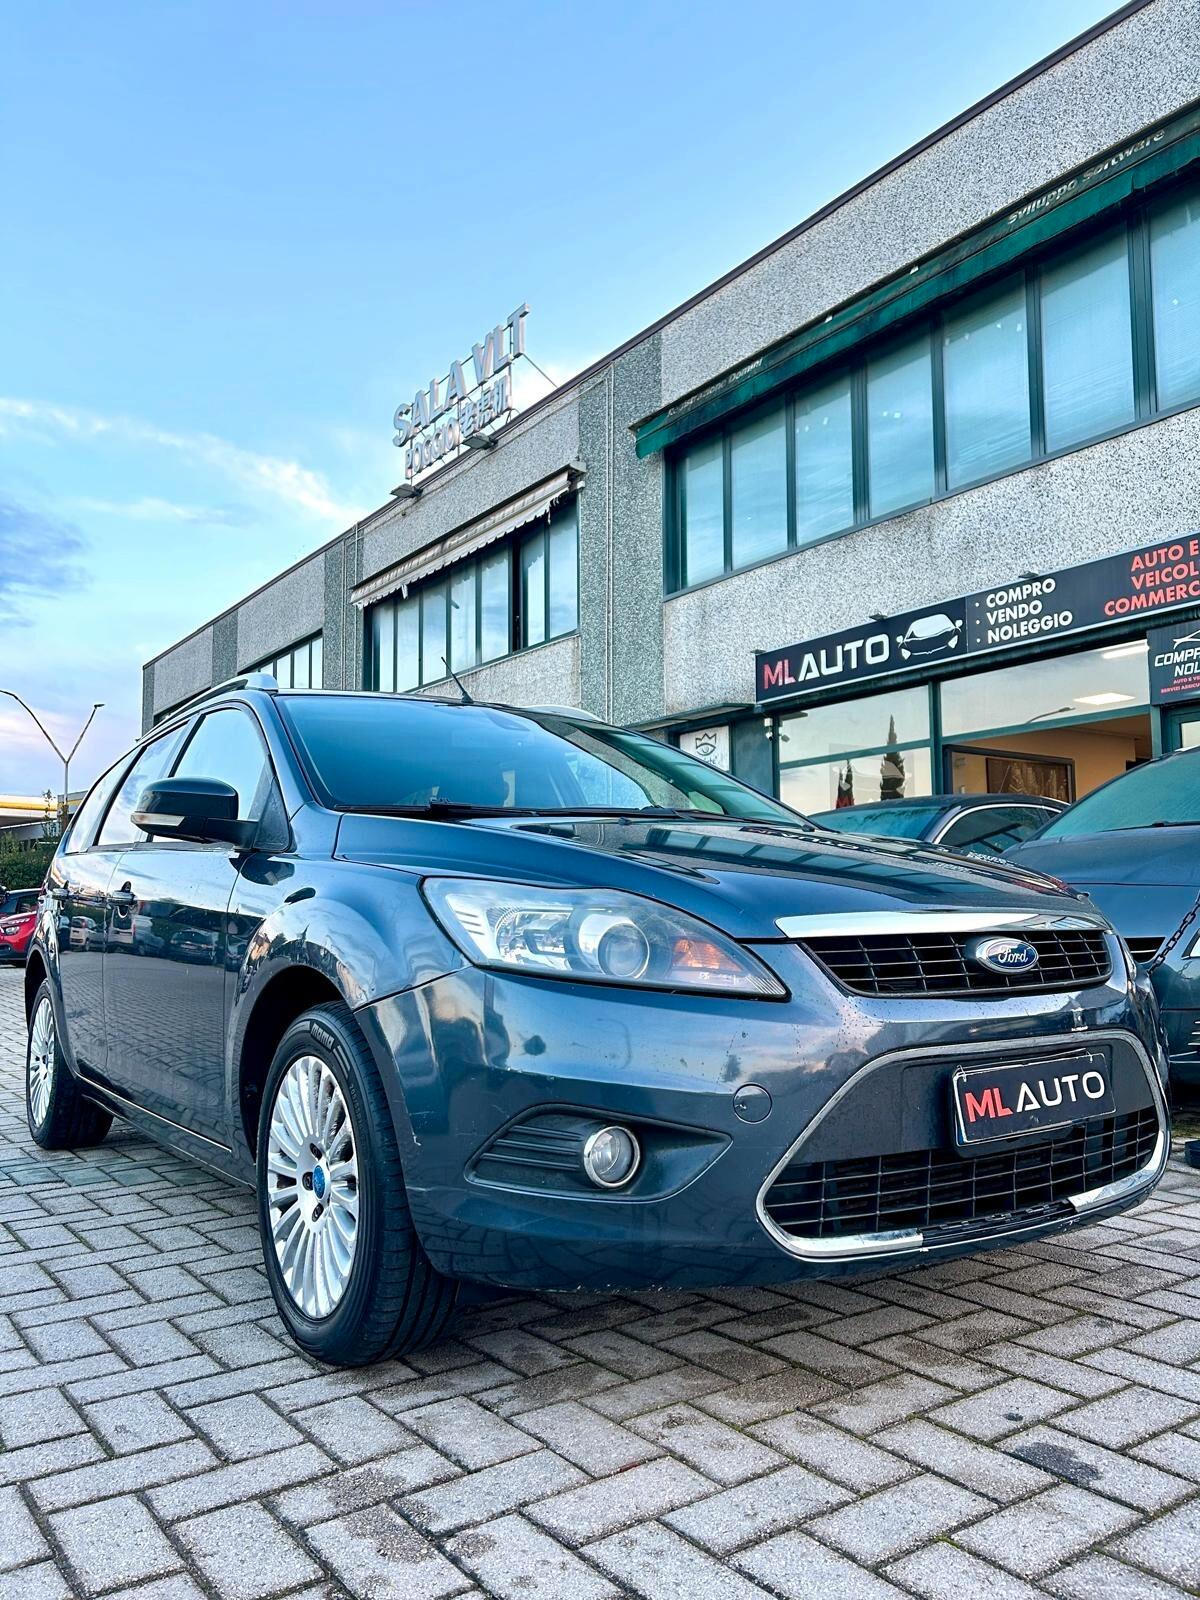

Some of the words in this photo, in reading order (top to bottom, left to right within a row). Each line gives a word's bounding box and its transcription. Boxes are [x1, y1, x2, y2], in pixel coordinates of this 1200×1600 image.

[392, 360, 467, 447] SALA
[471, 302, 530, 385] VLT
[1131, 544, 1184, 572] AUTO
[1189, 539, 1199, 556] E
[1131, 560, 1199, 590] VEICOL
[986, 578, 1056, 608] COMPRO
[1104, 580, 1200, 616] COMMERC
[986, 600, 1043, 625] VENDO
[987, 610, 1073, 644] NOLEGGIO
[997, 945, 1029, 965] Ford
